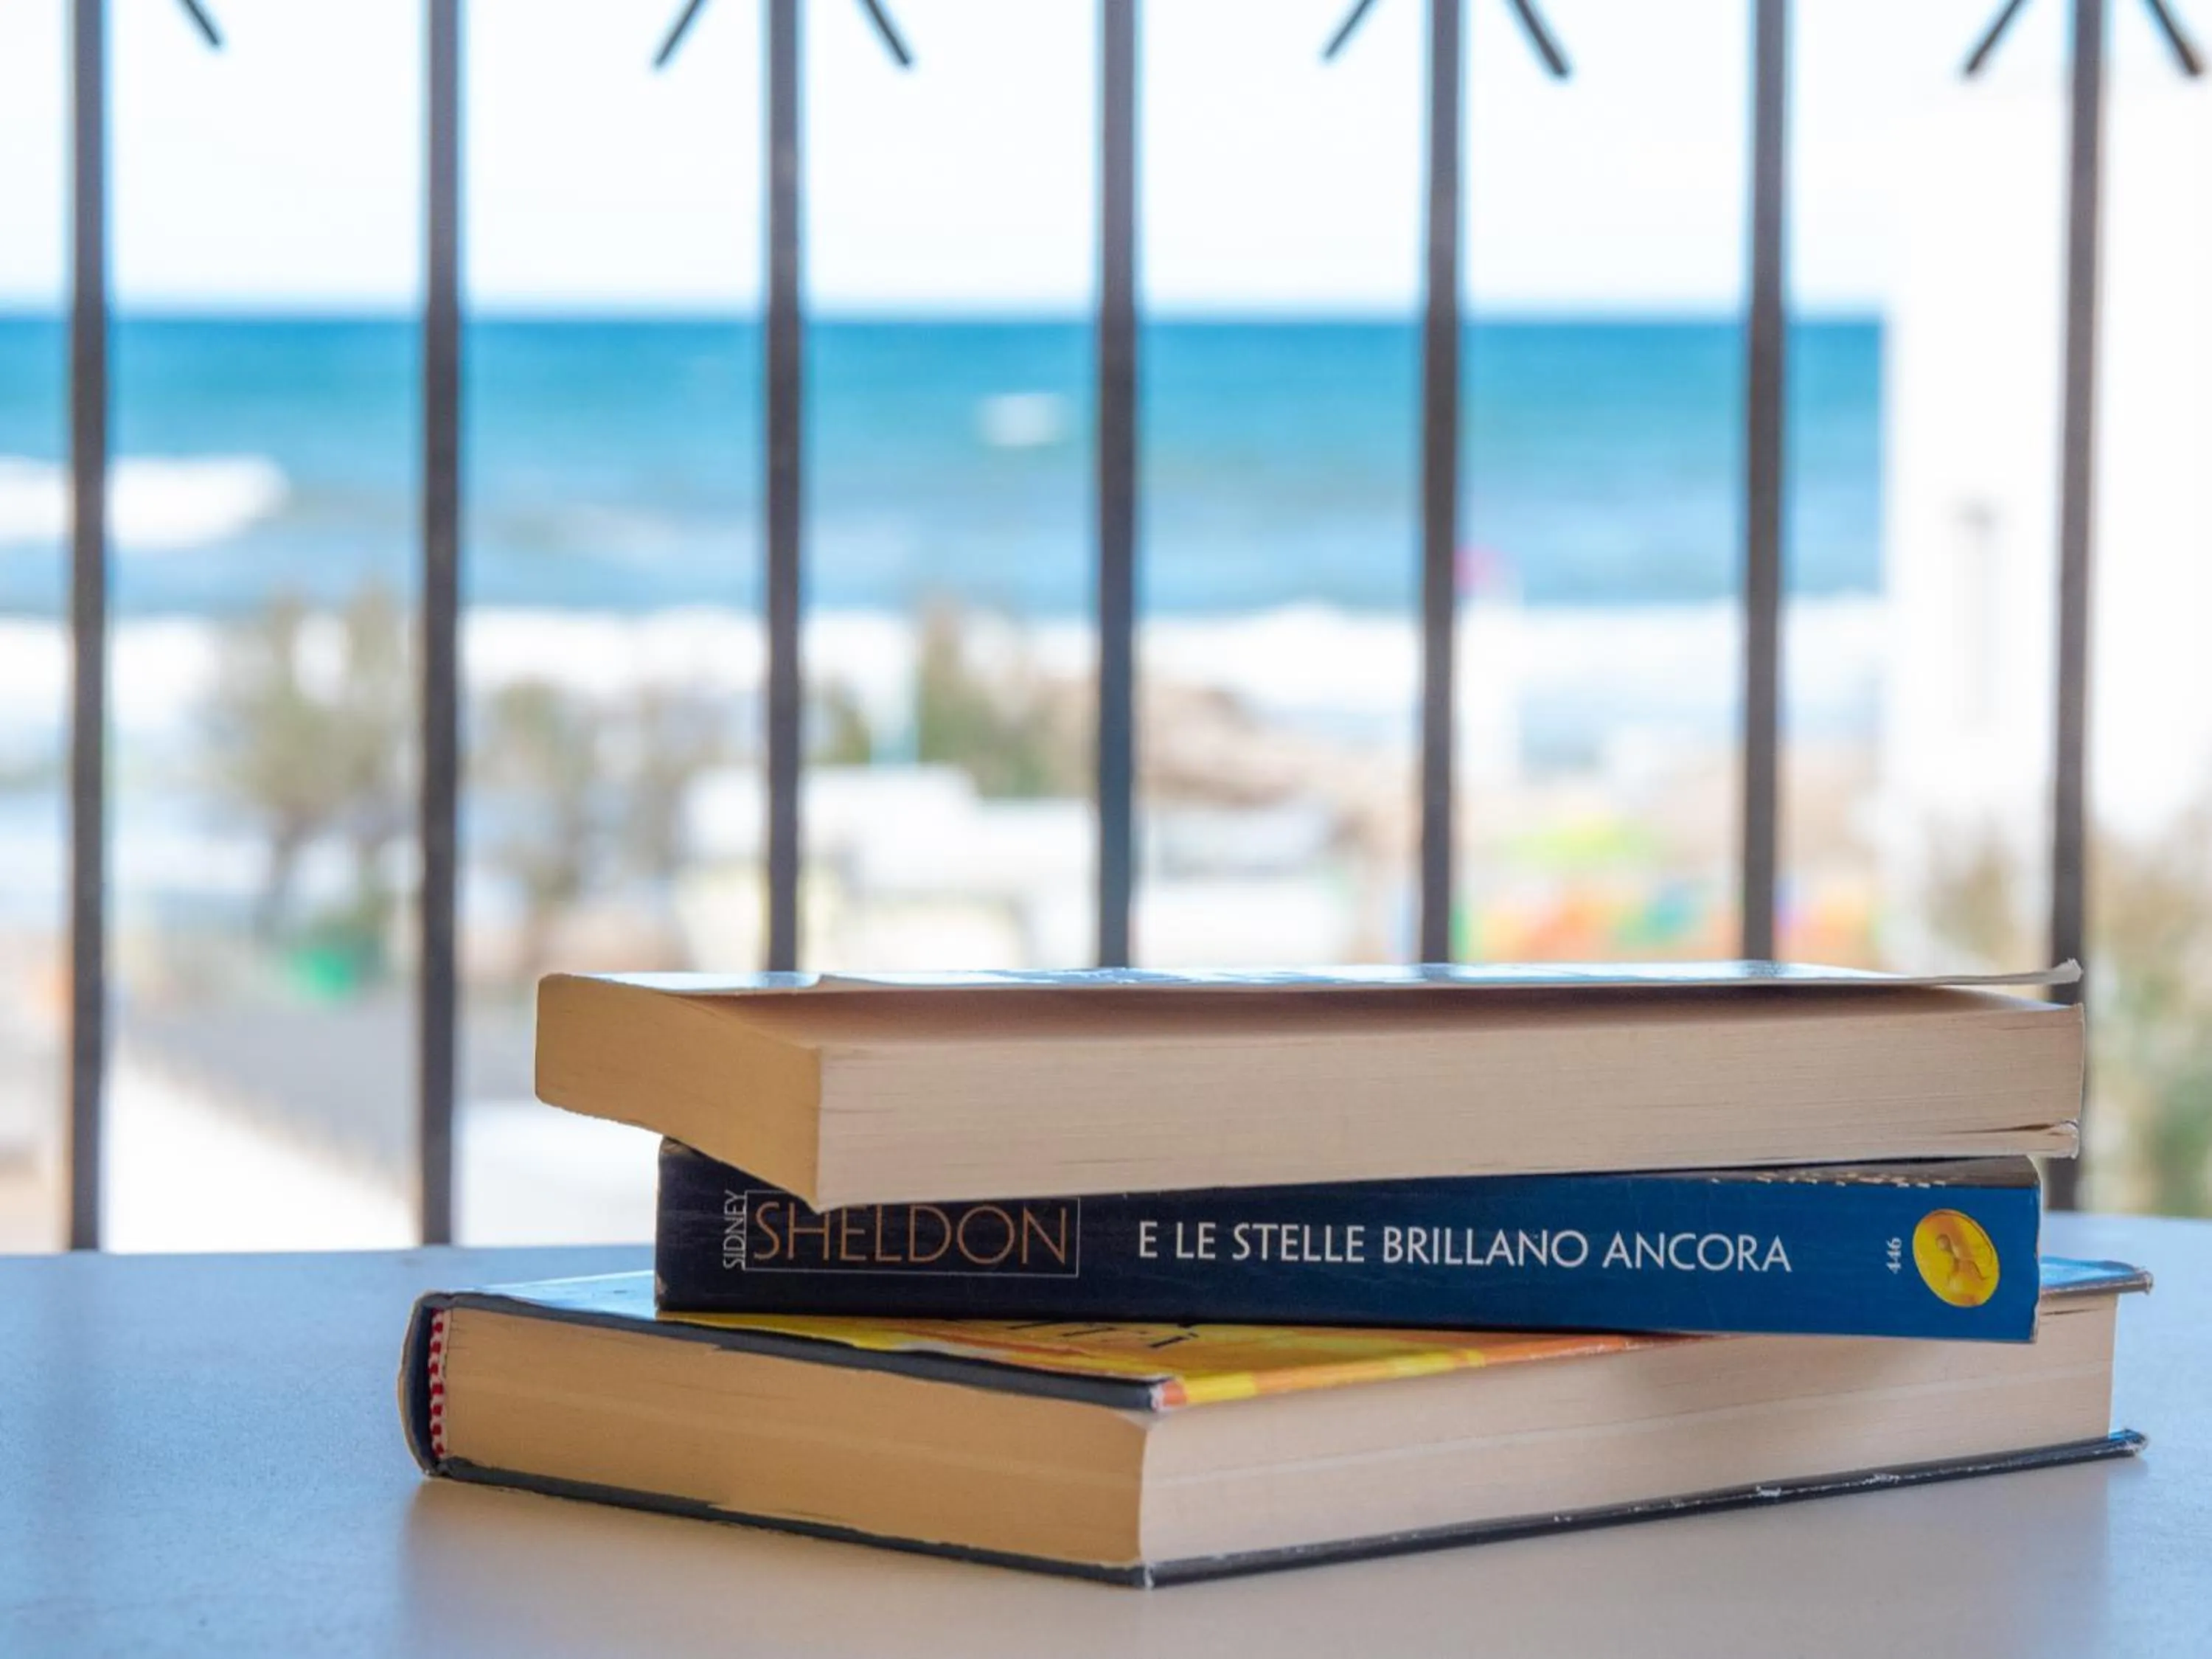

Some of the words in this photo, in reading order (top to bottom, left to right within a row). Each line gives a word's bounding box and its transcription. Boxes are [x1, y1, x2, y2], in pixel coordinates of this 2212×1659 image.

[723, 1189, 746, 1271] SIDNEY
[753, 1201, 1068, 1265] SHELDON
[1138, 1220, 1158, 1258] E
[1175, 1221, 1217, 1259] LE
[1232, 1222, 1366, 1263] STELLE
[1382, 1225, 1589, 1268] BRILLANO
[1601, 1231, 1792, 1273] ANCORA
[1885, 1237, 1902, 1275] 446
